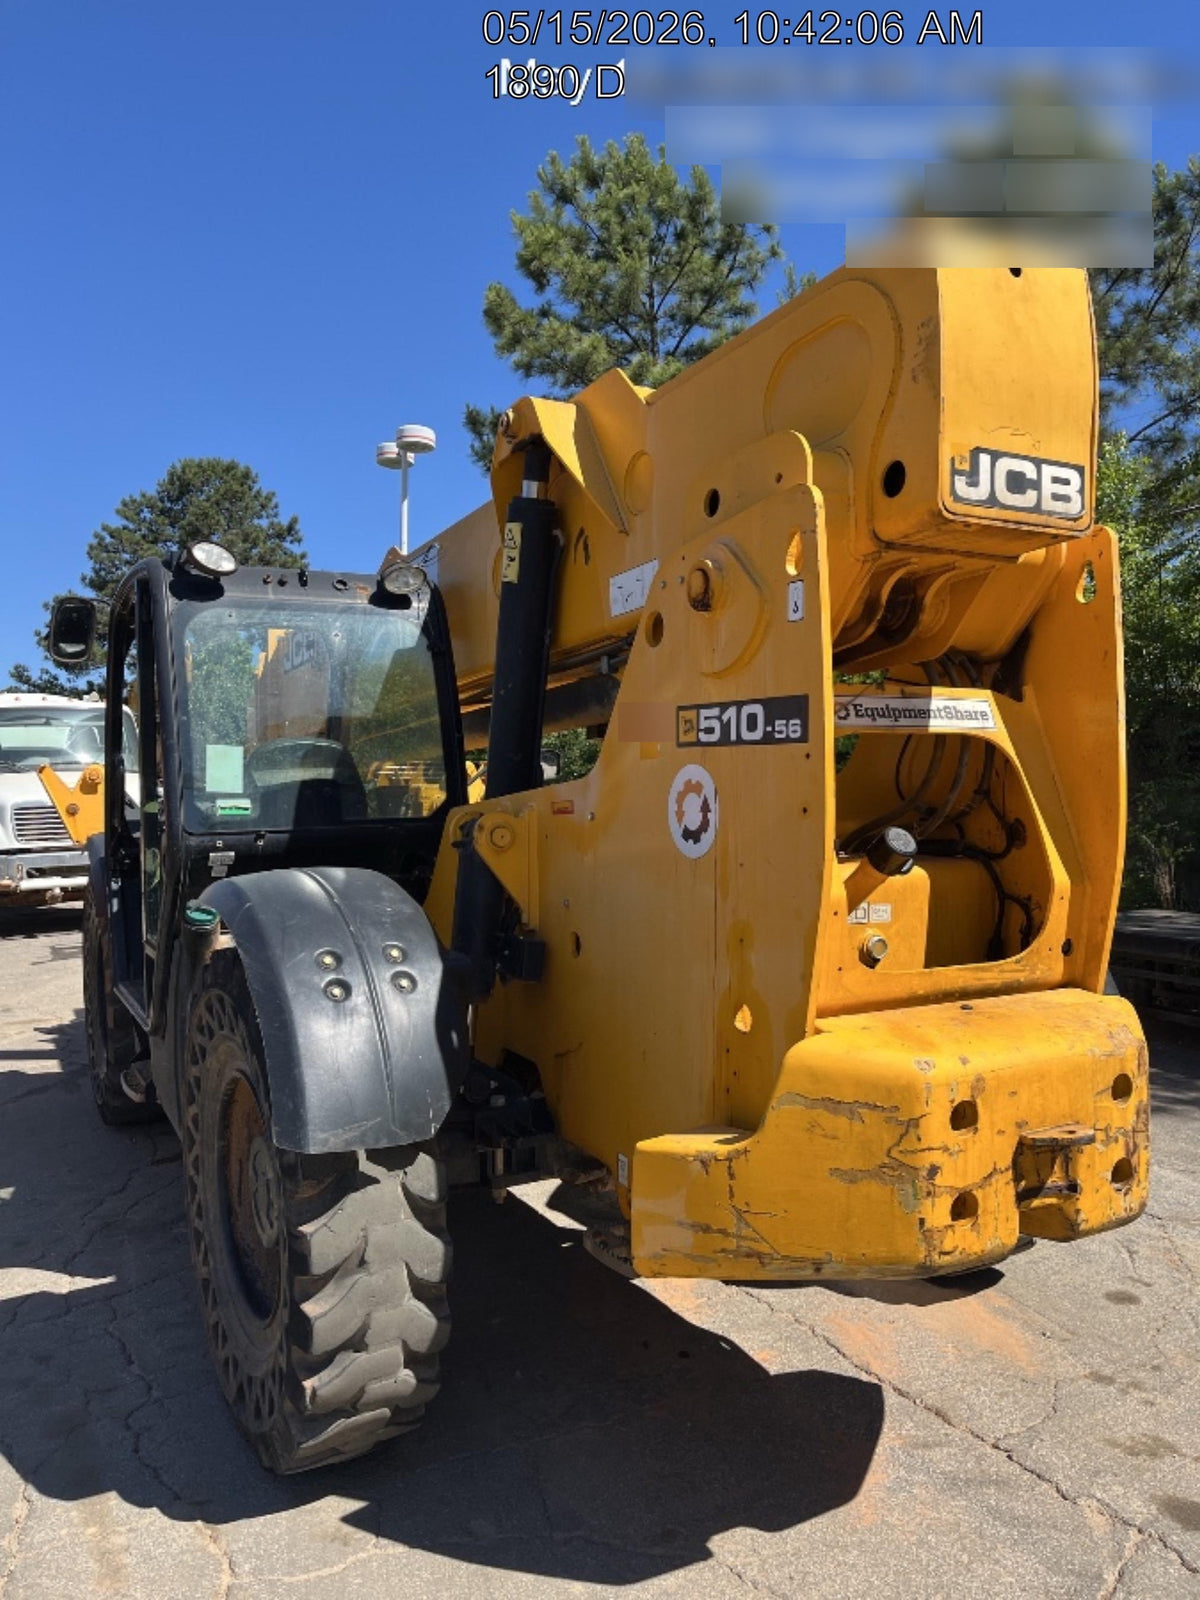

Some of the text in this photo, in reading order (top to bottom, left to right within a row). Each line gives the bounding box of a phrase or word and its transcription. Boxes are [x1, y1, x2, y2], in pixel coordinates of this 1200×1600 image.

[954, 453, 1083, 515] JCB
[698, 703, 802, 742] 510-56
[852, 703, 990, 723] EquipmentShare
